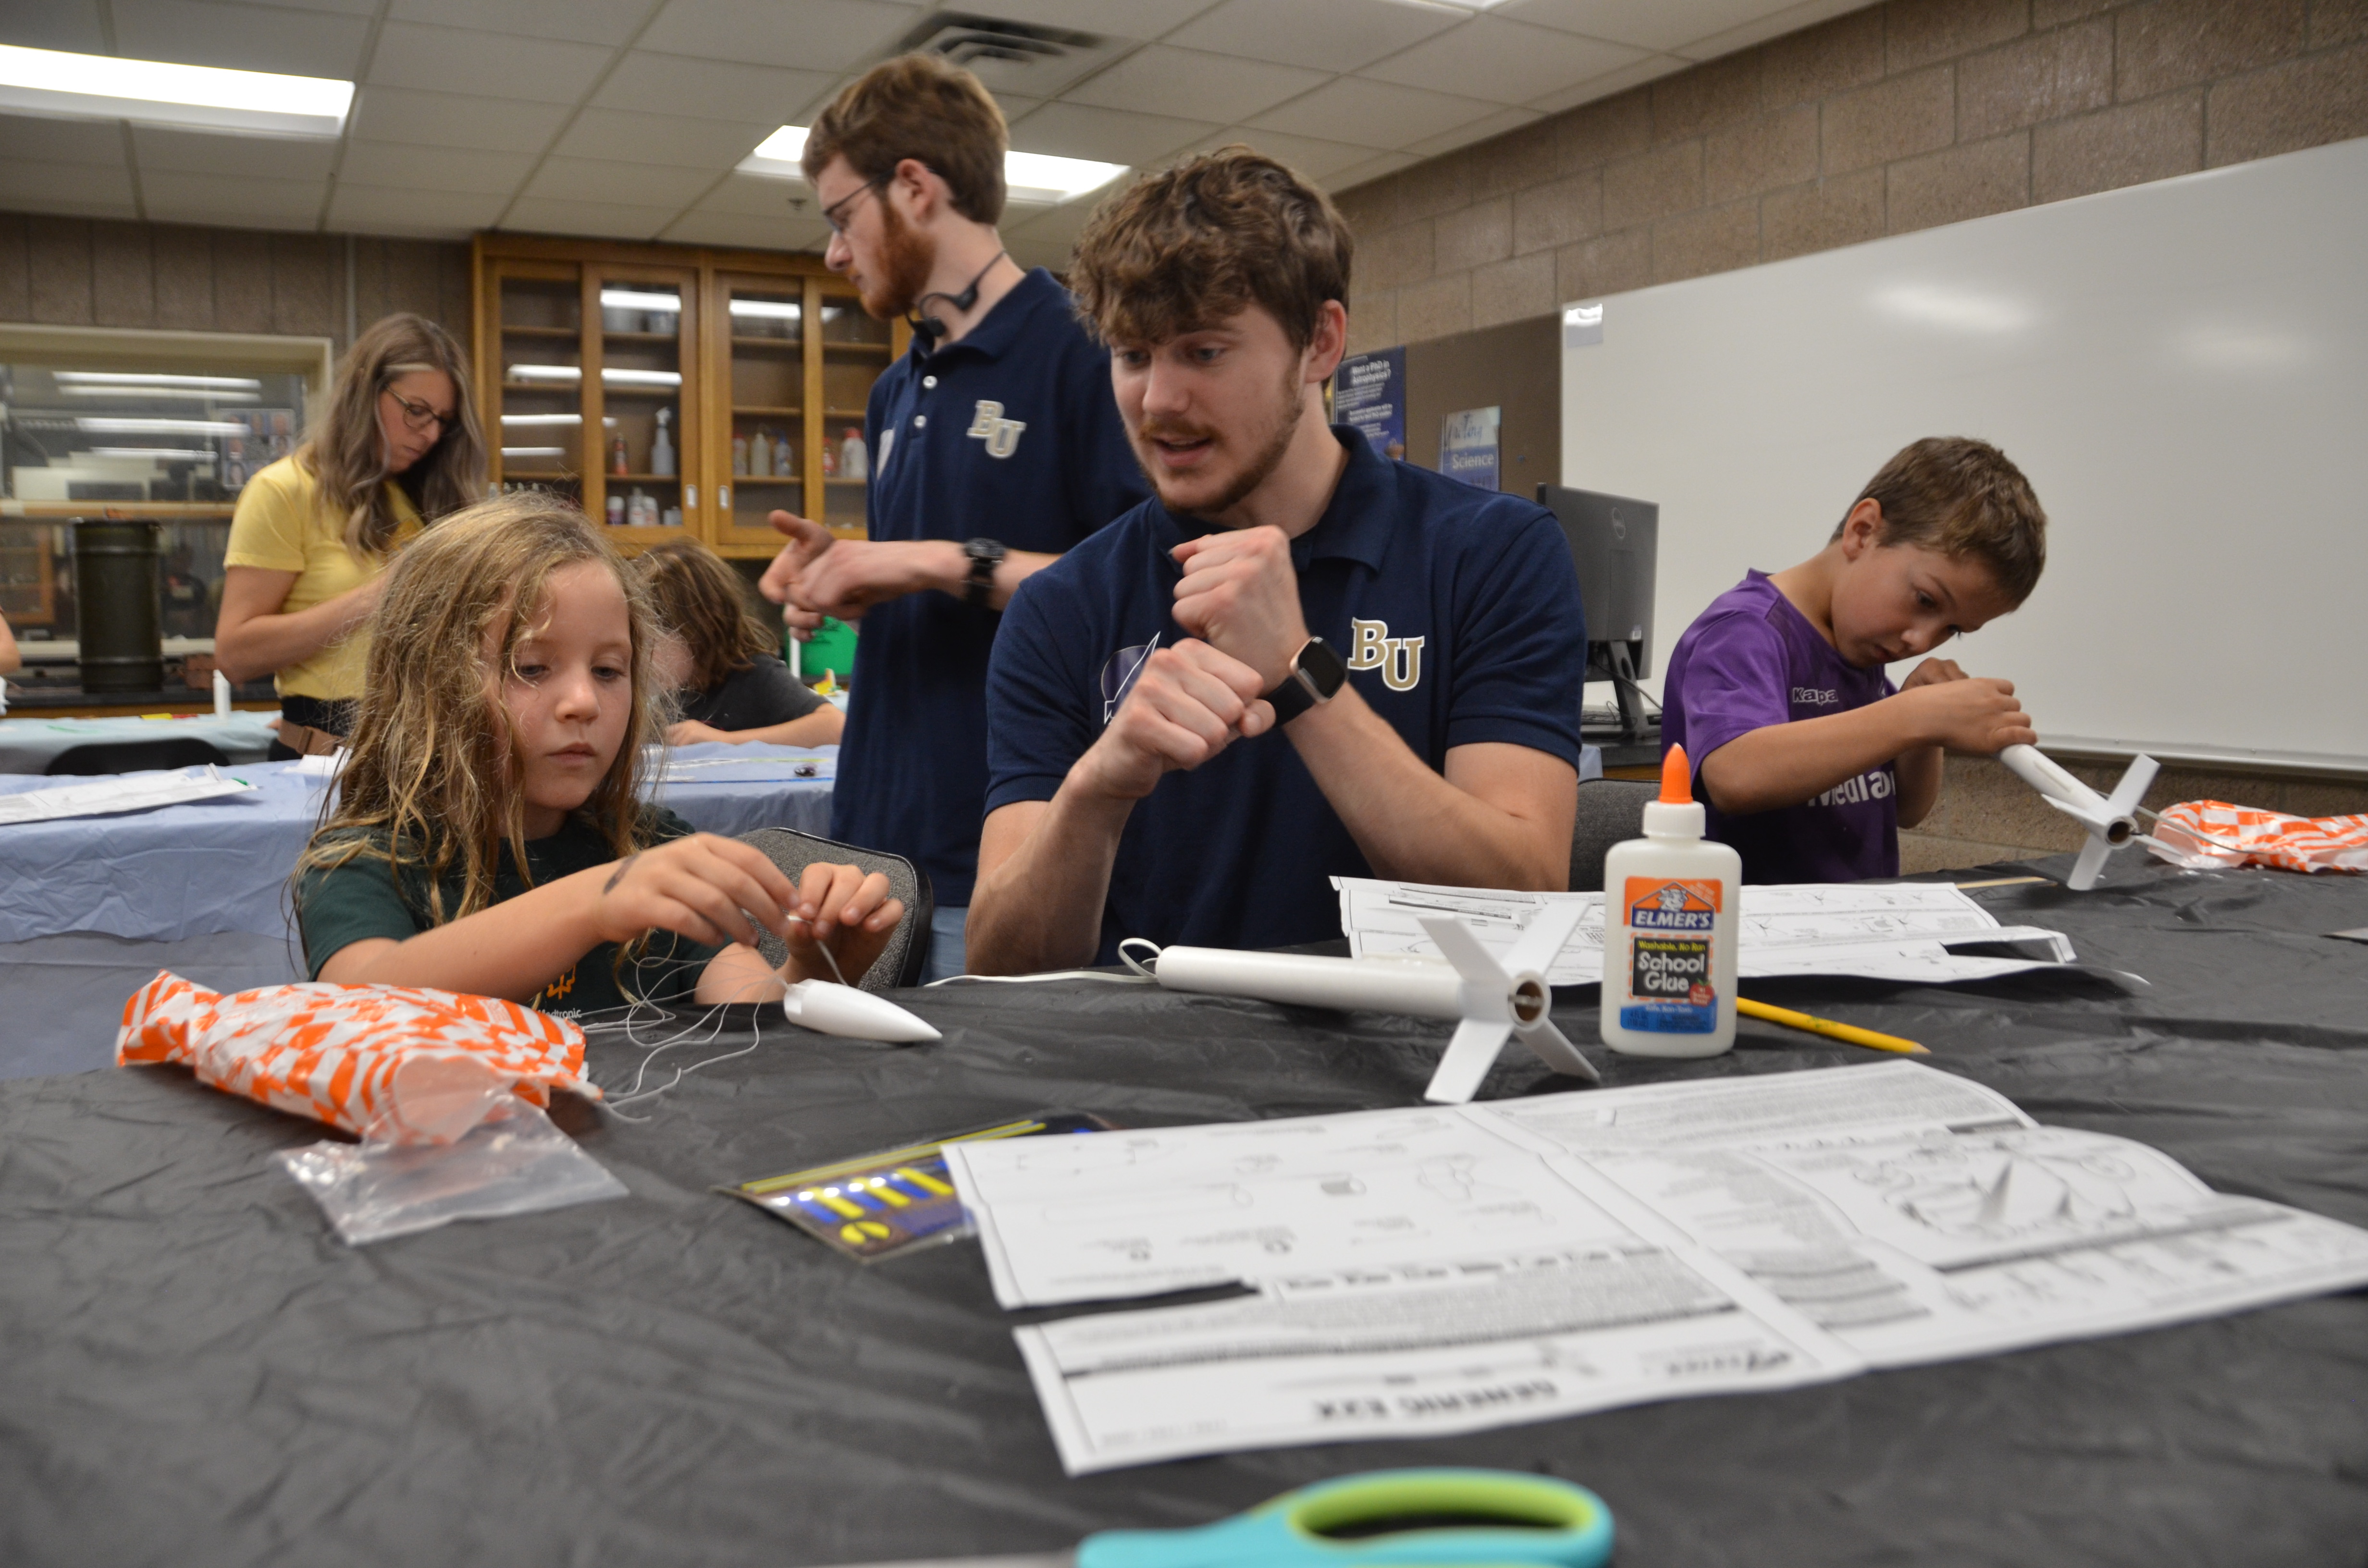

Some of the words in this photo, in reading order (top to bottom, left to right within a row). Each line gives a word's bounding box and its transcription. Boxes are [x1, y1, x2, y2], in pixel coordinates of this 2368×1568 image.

[966, 399, 1027, 459] BU
[1452, 451, 1494, 470] Science
[1347, 617, 1425, 692] BU
[1635, 910, 1711, 929] ELMER'S
[1679, 942, 1690, 951] No
[1691, 942, 1705, 952] Run
[1638, 950, 1705, 973] School
[1644, 971, 1690, 992] Glue
